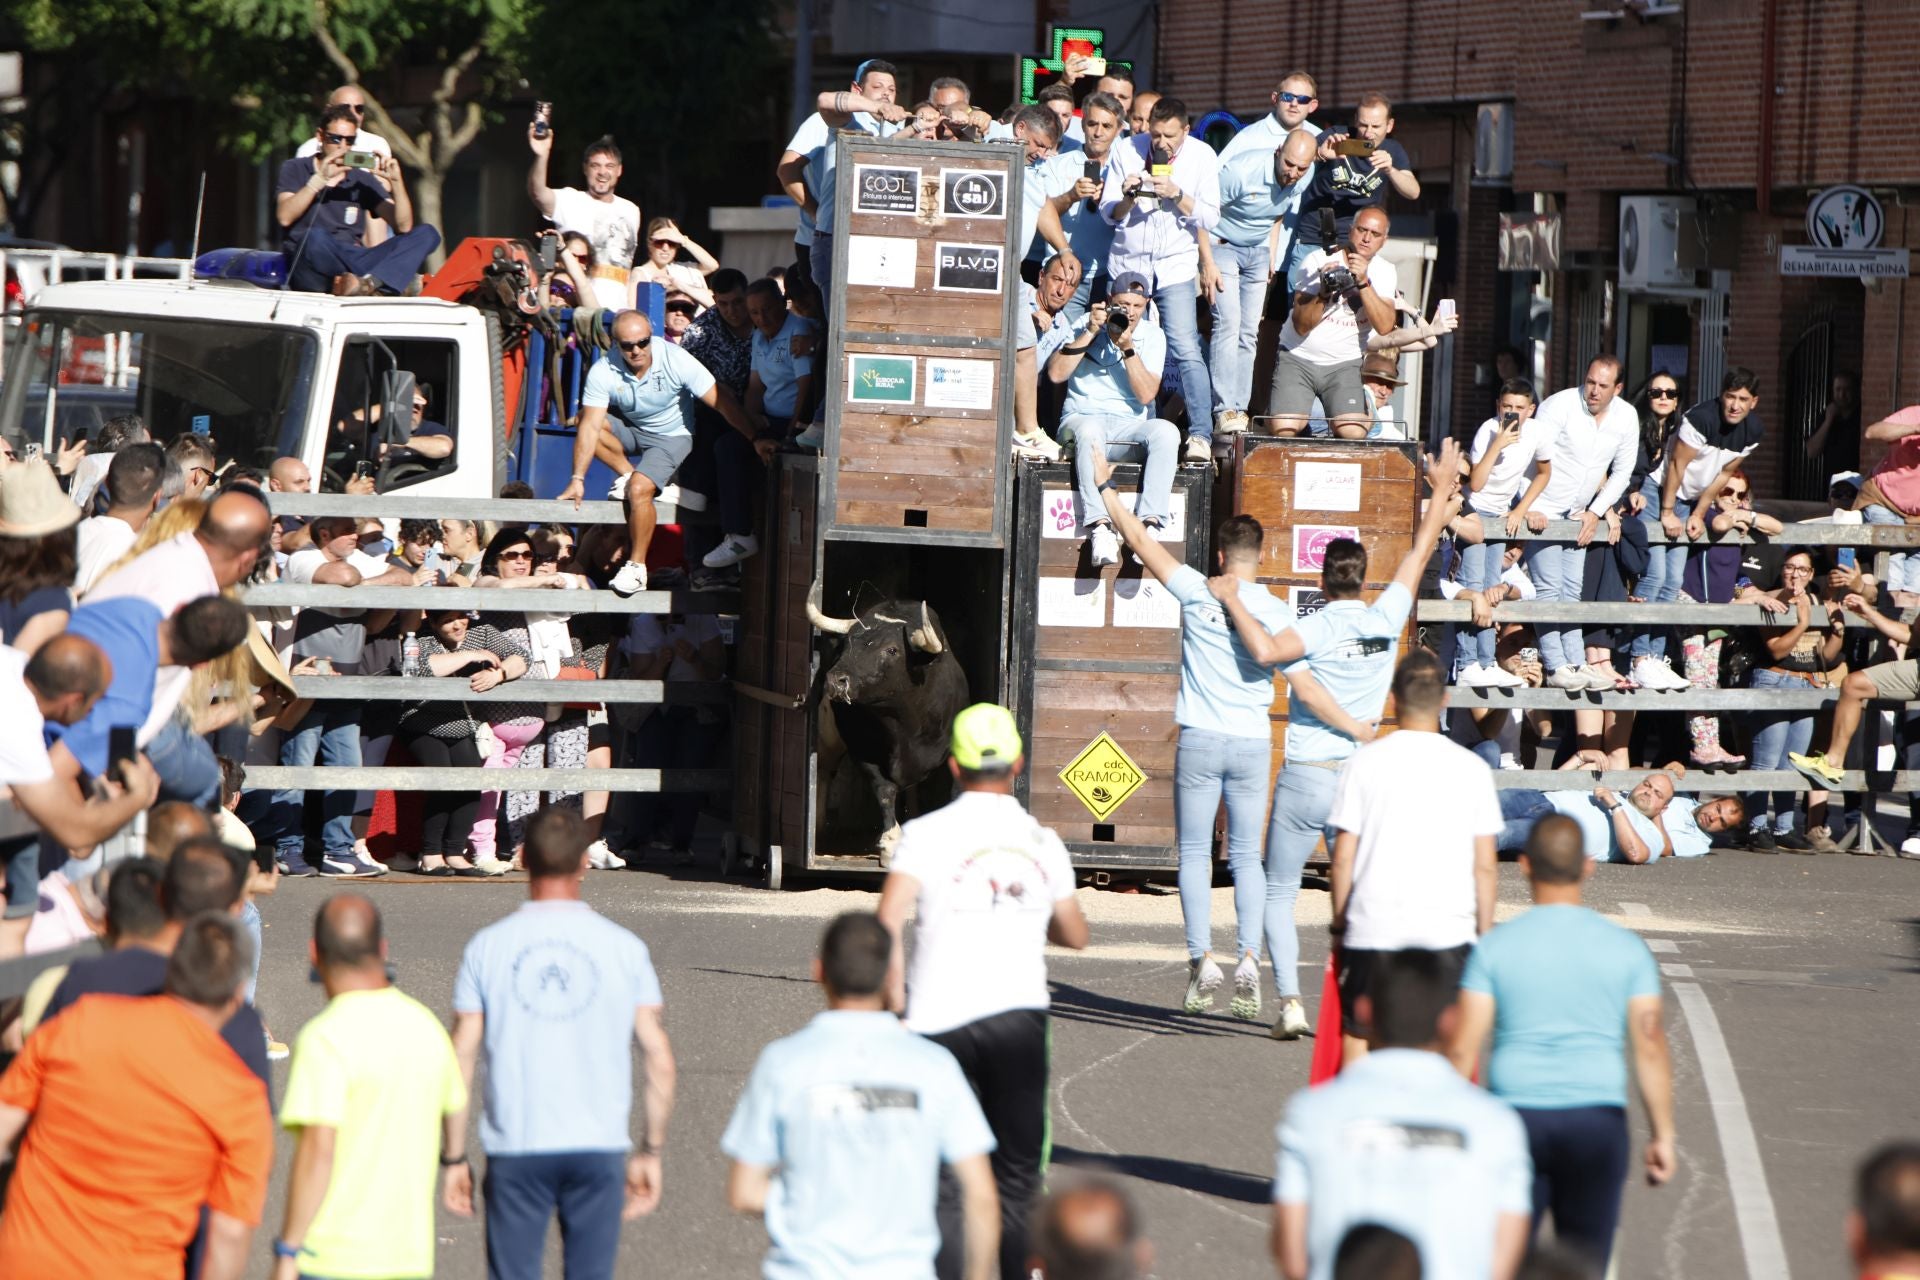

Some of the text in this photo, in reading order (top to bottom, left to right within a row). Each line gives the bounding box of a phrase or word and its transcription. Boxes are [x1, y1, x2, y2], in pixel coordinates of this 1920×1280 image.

[969, 180, 981, 192] la
[962, 190, 988, 204] sal
[942, 255, 998, 269] BLVD
[1783, 261, 1906, 275] REHABITALIA MEDINA
[1103, 760, 1124, 769] cdc
[1073, 770, 1133, 783] RAMON
